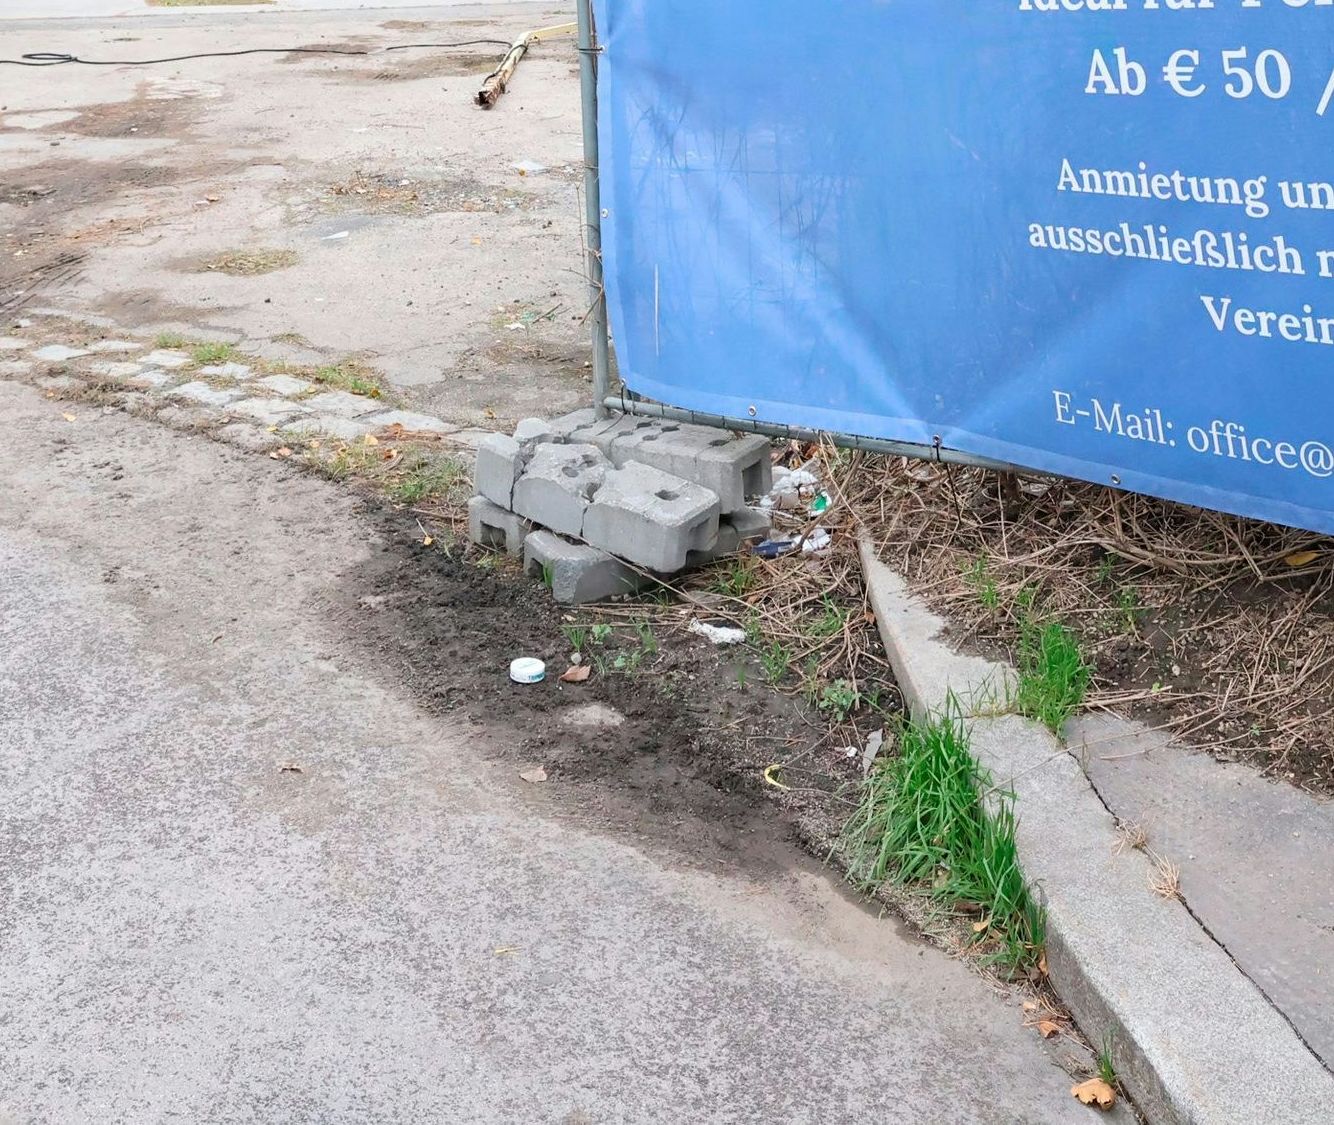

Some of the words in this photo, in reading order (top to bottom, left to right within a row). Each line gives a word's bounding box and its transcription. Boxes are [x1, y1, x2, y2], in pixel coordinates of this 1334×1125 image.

[1085, 46, 1146, 95] Ab
[1163, 49, 1206, 97] €
[1222, 46, 1291, 99] 50
[1057, 158, 1269, 218] Anmietung
[1029, 222, 1305, 274] ausschließlich
[1053, 391, 1176, 448] E-Mail:
